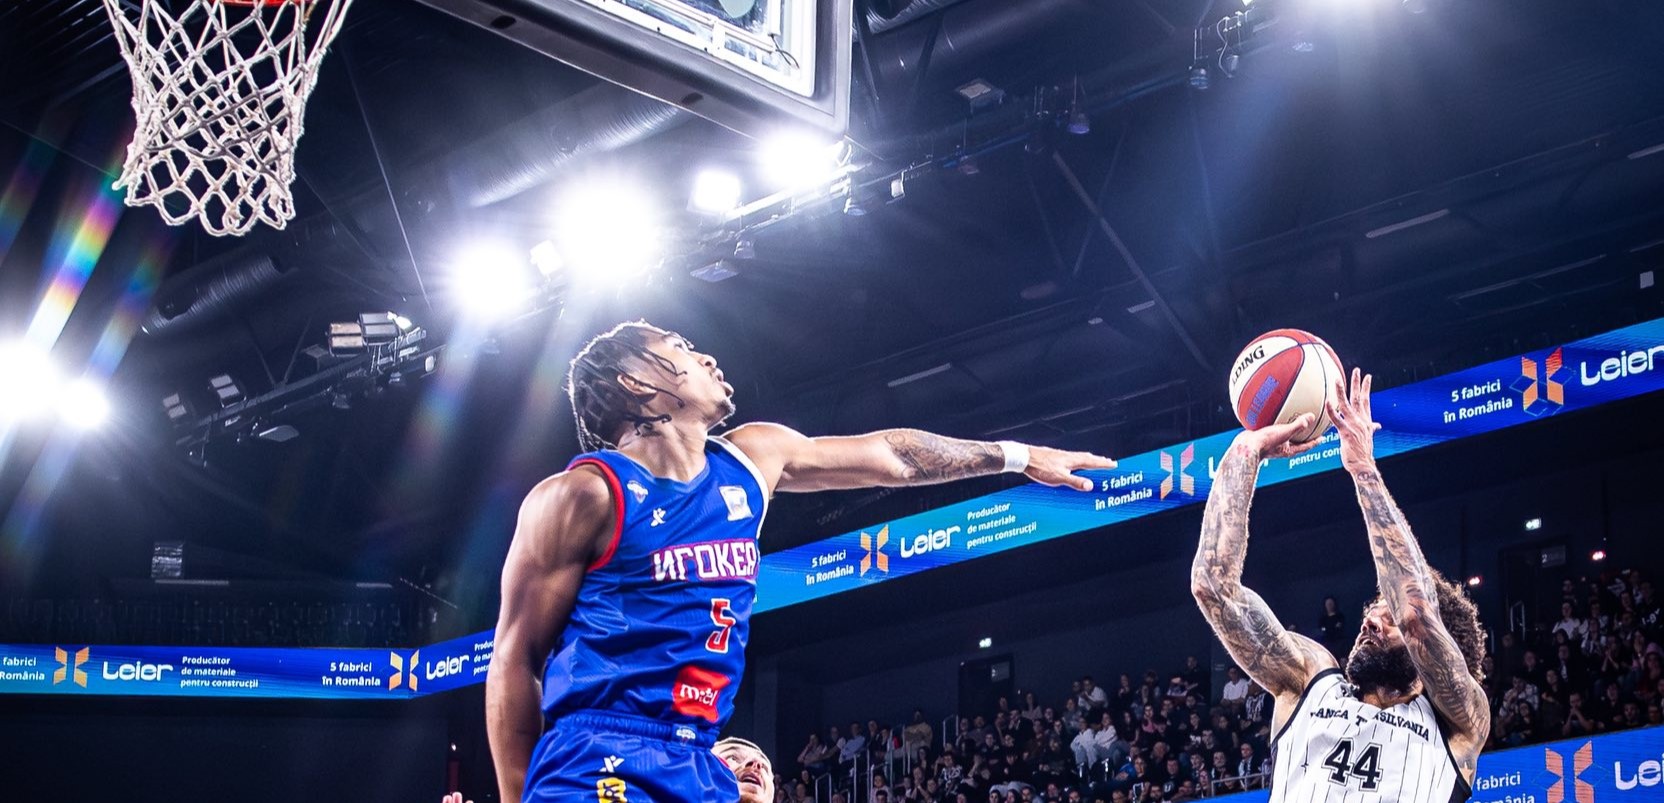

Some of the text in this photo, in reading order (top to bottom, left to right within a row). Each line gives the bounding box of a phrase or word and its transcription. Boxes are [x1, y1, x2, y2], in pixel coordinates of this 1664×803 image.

[1581, 345, 1664, 386] Leier
[1451, 379, 1501, 403] 5 fabrici
[1443, 397, 1513, 424] în România
[1289, 451, 1321, 470] pentru
[1102, 470, 1143, 492] 5 fabrici
[1107, 487, 1153, 507] România
[967, 514, 1017, 535] de materiale
[900, 525, 961, 558] Leier
[966, 535, 994, 550] pentru
[811, 549, 847, 568] 5 fabrici
[816, 564, 854, 583] România
[705, 598, 737, 654] 5
[474, 640, 494, 652] Produc
[2, 656, 37, 666] fabrici
[182, 656, 231, 665] Producător
[329, 661, 372, 672] 5 fabrici
[425, 654, 470, 681] Leier
[0, 670, 45, 681] România
[102, 660, 174, 681] Leier
[181, 667, 237, 677] de materiale
[180, 678, 211, 689] pentru
[321, 675, 381, 687] în România
[1321, 737, 1384, 793] 44
[1475, 771, 1521, 791] fabrici
